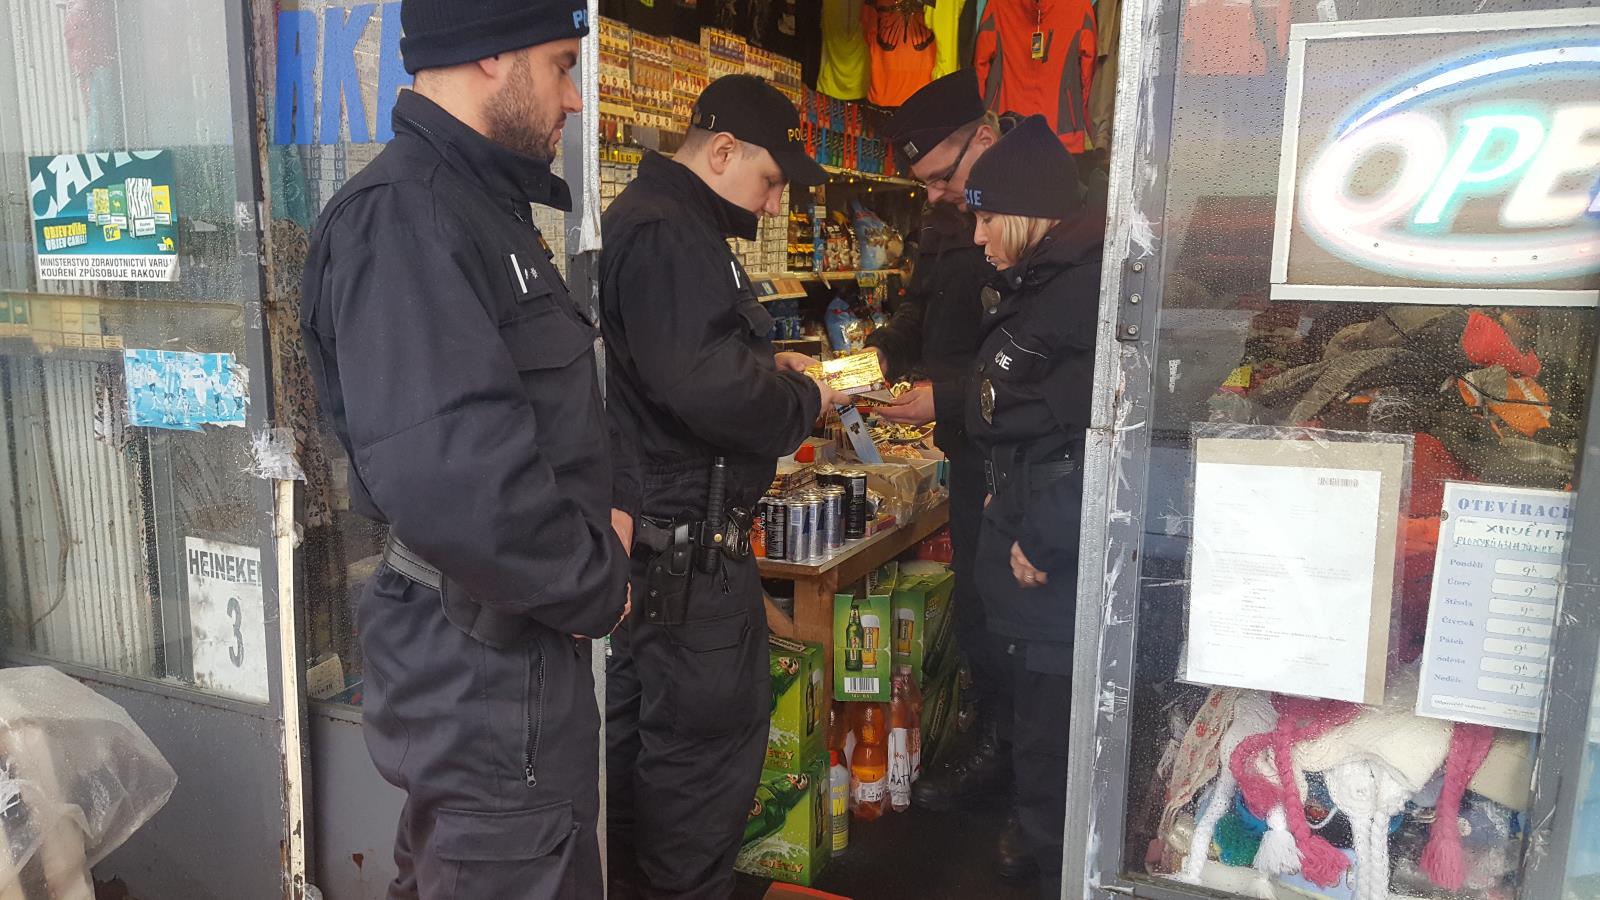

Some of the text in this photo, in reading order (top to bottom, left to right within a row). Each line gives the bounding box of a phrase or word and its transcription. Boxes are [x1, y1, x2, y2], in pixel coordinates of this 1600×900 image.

[30, 150, 163, 220] CAM
[1303, 105, 1600, 232] OPE
[40, 257, 172, 268] MINISTERSTVO ZDRAVOTNICTVÍ VARU
[41, 266, 76, 278] KOUŘENÍ
[79, 267, 129, 278] ZPŮSOBUJE
[227, 597, 244, 668] 3
